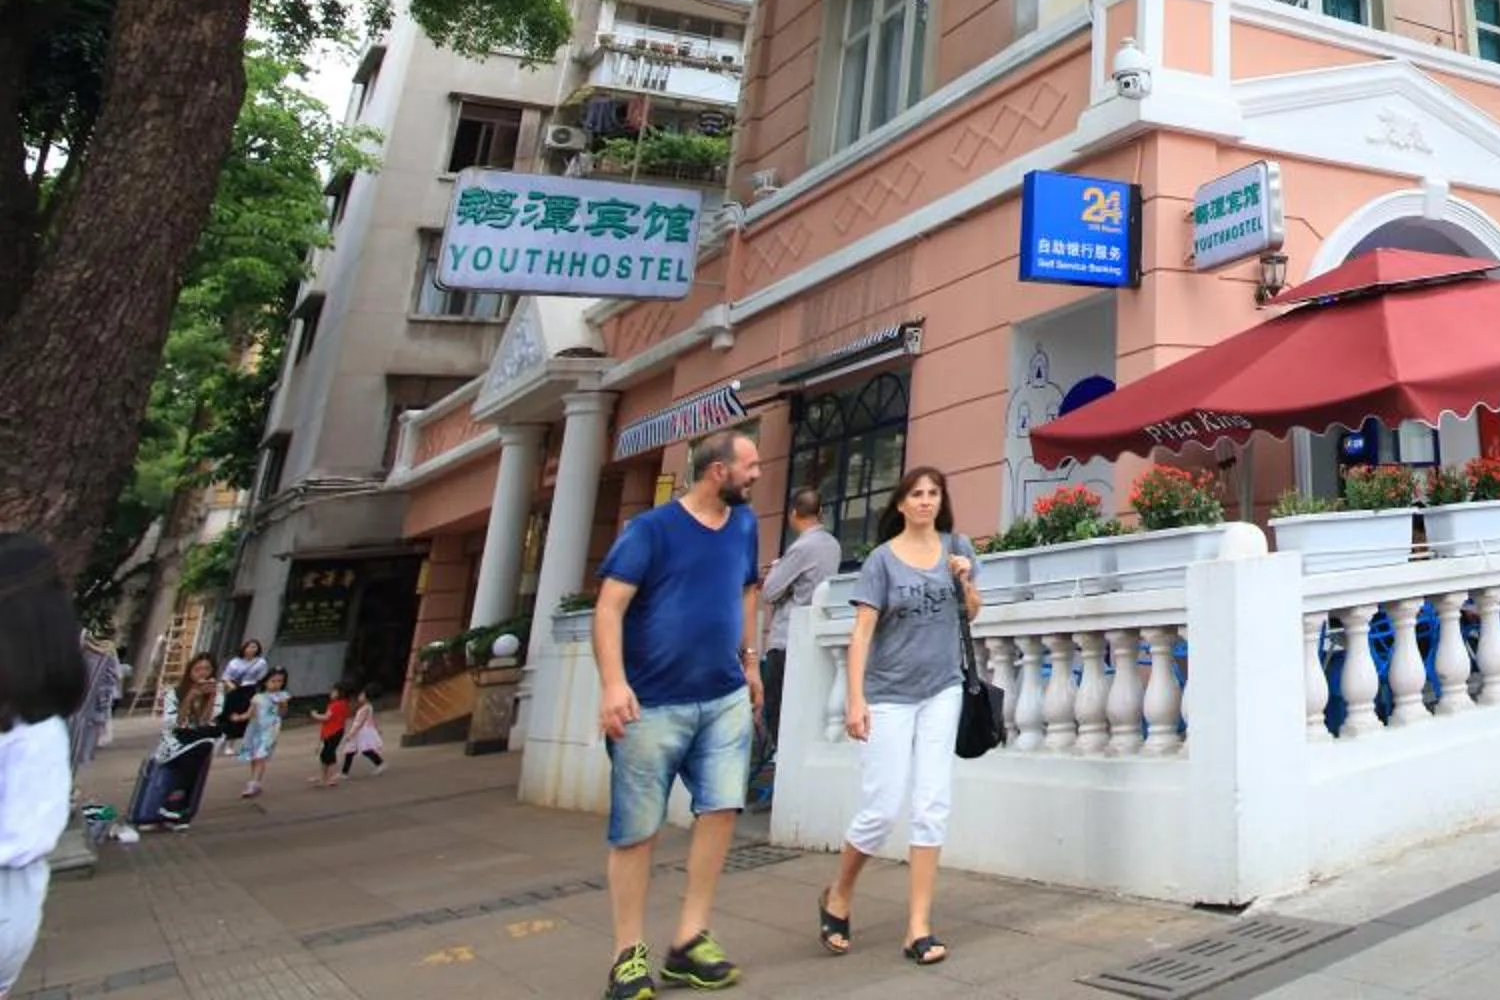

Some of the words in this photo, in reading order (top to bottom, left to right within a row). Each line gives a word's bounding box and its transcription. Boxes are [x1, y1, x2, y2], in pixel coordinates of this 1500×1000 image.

[1082, 187, 1122, 225] 24
[1037, 237, 1121, 262] 自助银行服务
[1143, 420, 1198, 443] Pita
